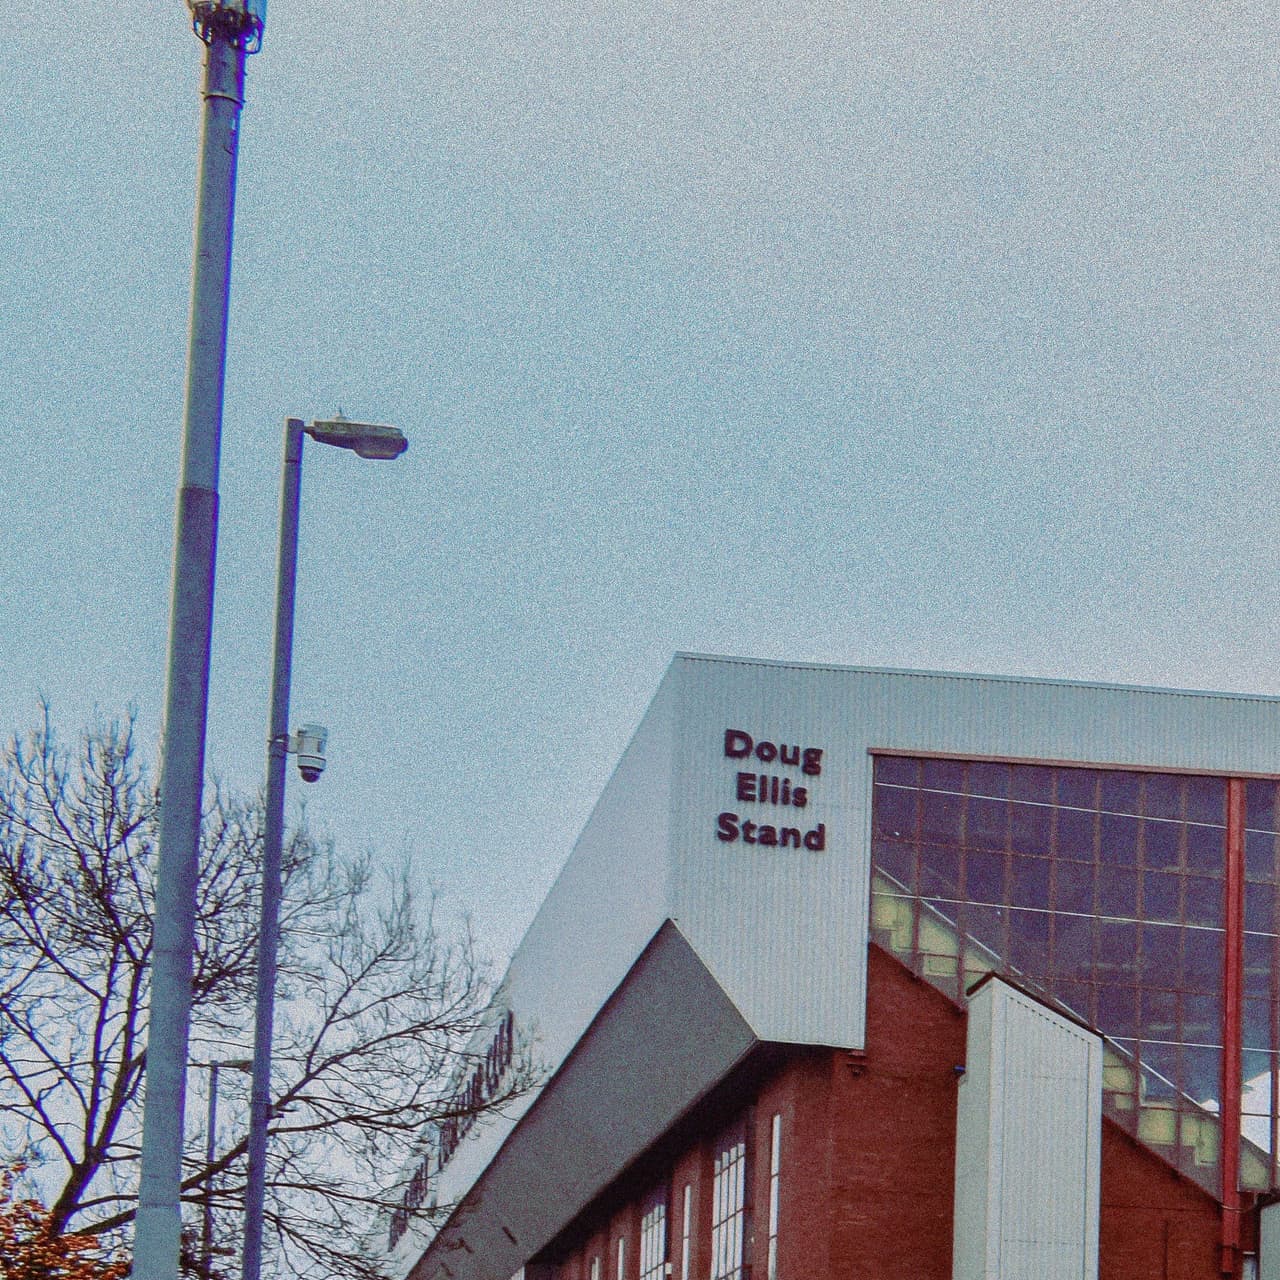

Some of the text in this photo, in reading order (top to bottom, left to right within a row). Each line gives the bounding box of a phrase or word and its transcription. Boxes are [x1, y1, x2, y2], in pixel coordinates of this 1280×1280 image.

[724, 728, 823, 776] Doug
[736, 771, 808, 808] Ellis
[716, 812, 826, 851] Stand
